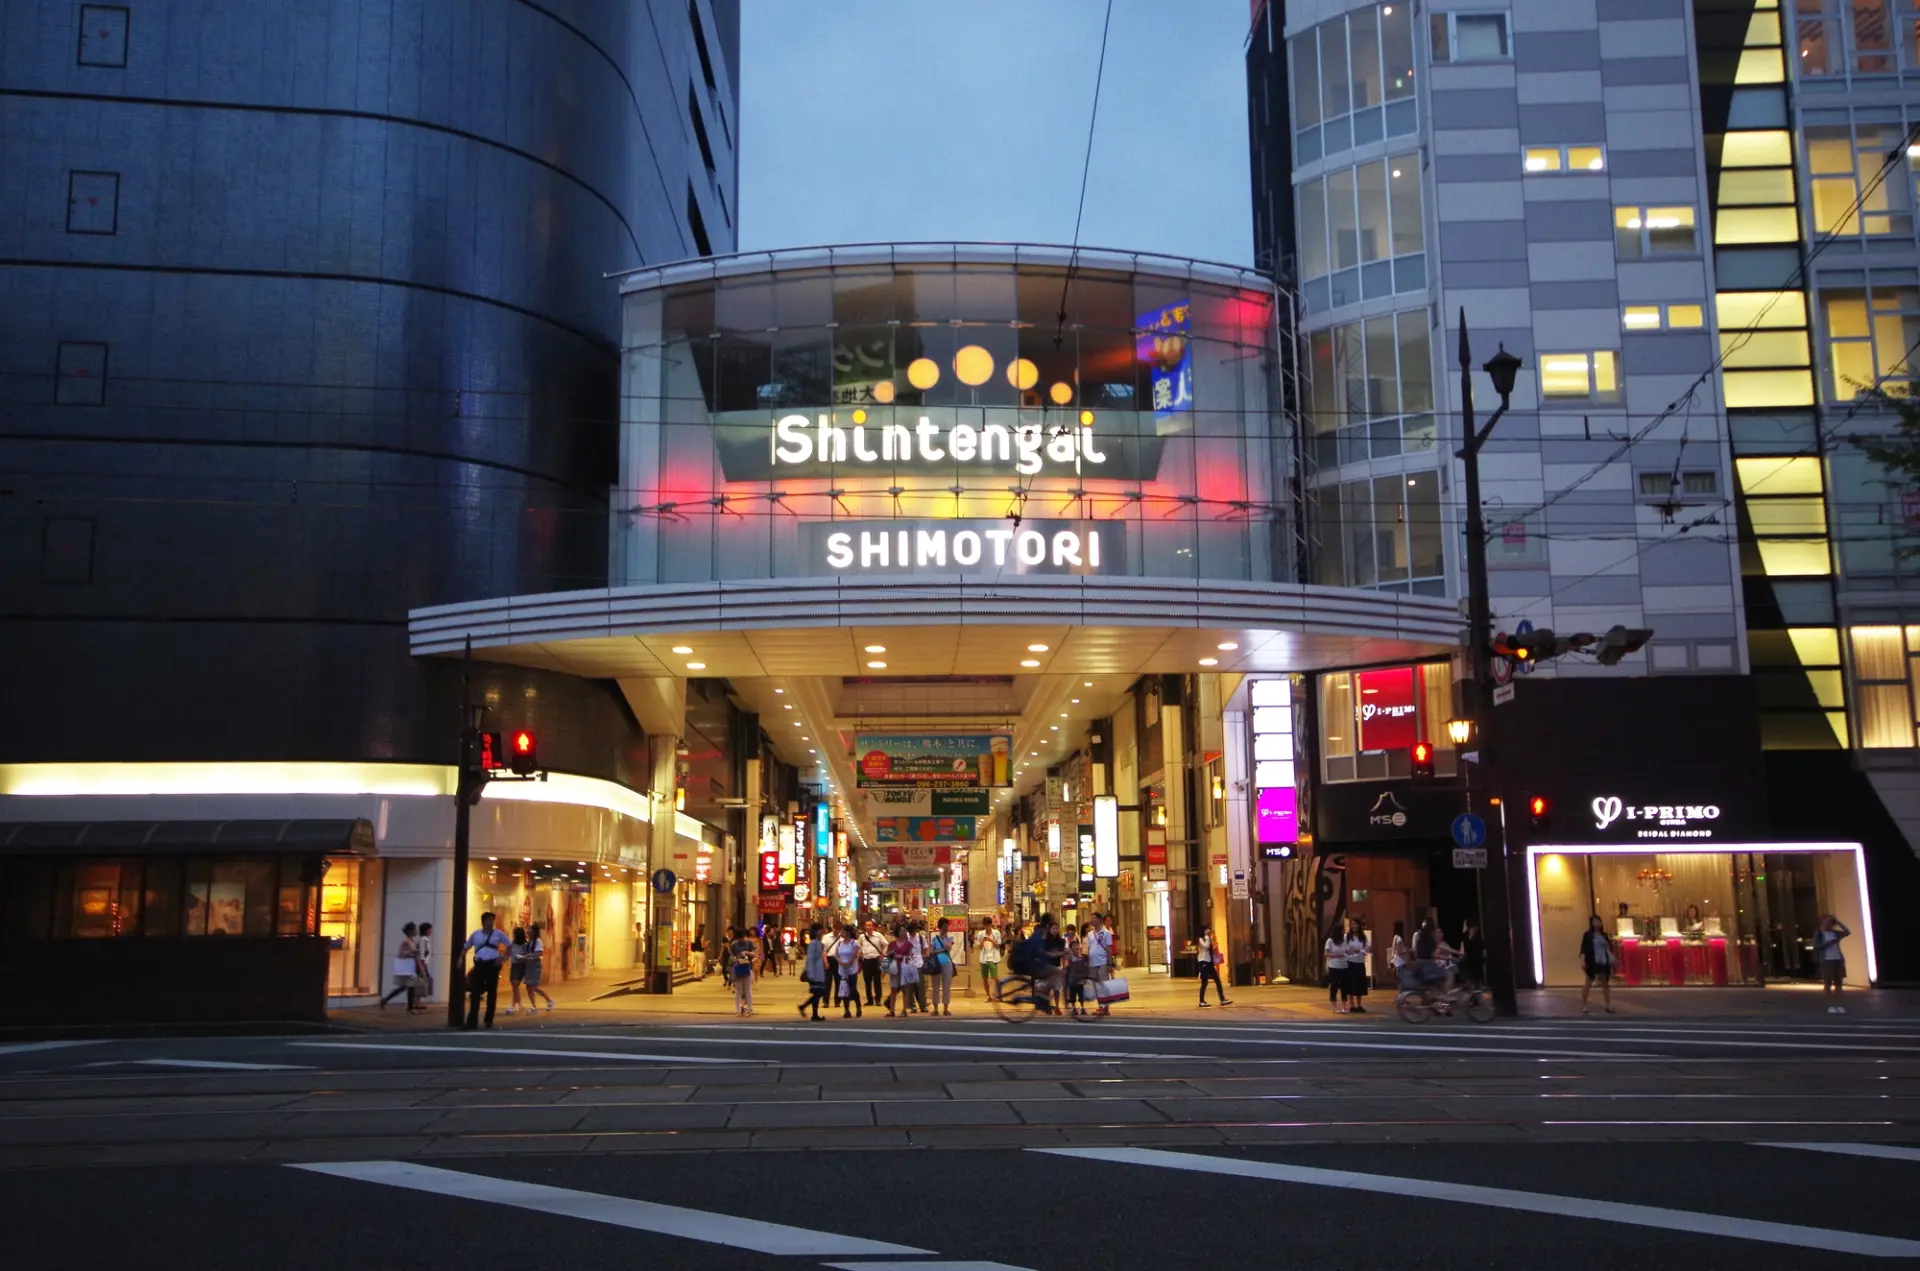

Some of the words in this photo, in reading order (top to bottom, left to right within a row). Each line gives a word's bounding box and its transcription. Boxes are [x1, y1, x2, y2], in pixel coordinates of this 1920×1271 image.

[774, 410, 1106, 474] Shintengai
[826, 530, 1101, 568] SHIMOTORI
[1626, 805, 1720, 819] I-PRIMO
[1637, 829, 1669, 838] BRIDAL
[1670, 829, 1712, 838] DIAMOND
